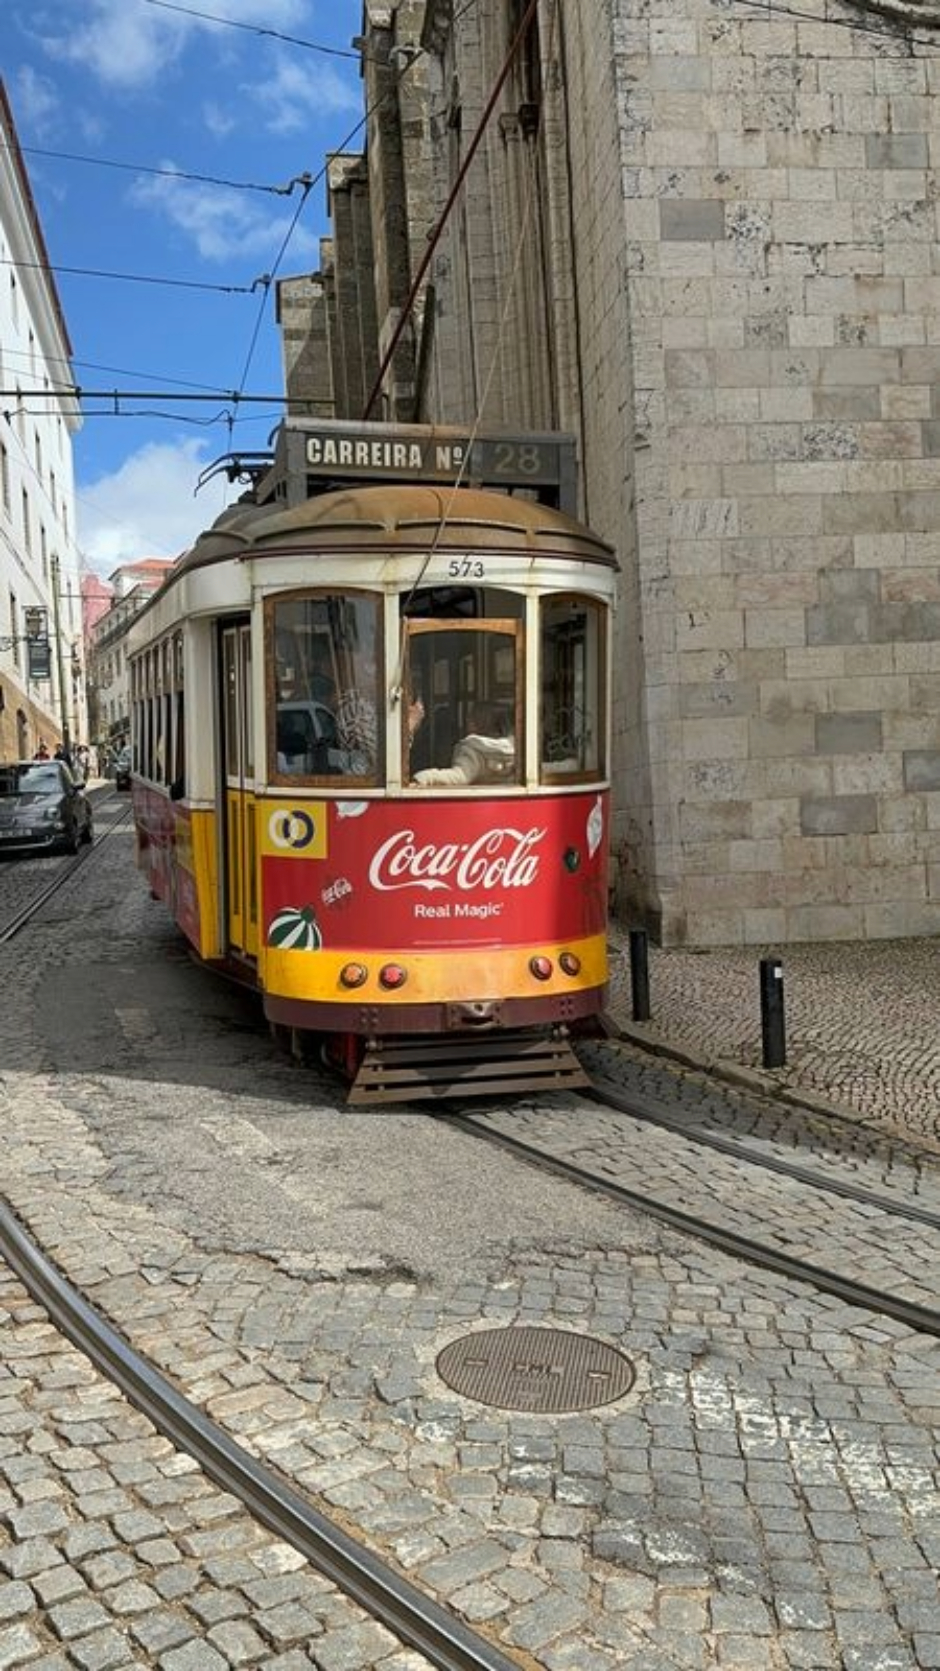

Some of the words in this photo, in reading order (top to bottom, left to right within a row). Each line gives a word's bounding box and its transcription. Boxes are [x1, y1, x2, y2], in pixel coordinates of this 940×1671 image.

[307, 438, 422, 468] CARREIRA
[494, 445, 541, 475] 28
[449, 561, 485, 578] 573
[368, 827, 548, 891] Coca-Cola
[414, 904, 451, 918] Real
[454, 903, 501, 919] Magic
